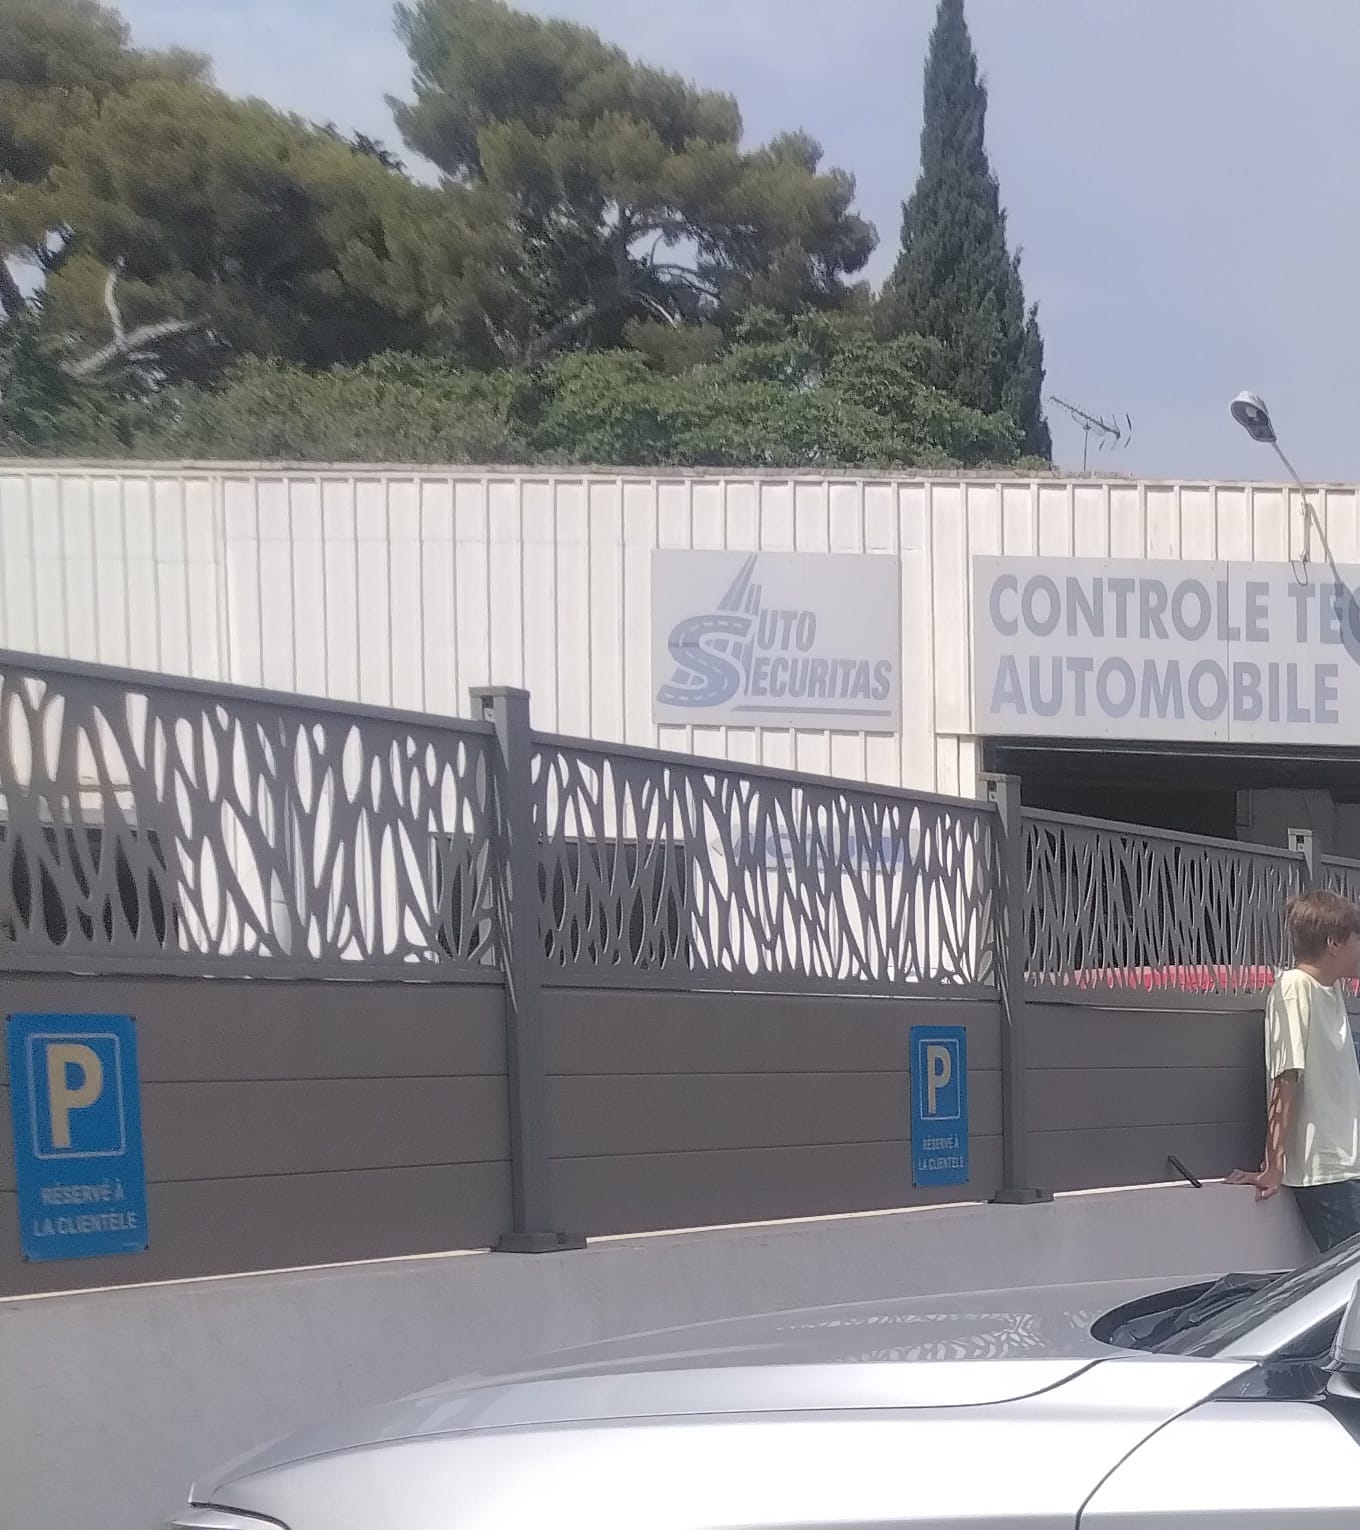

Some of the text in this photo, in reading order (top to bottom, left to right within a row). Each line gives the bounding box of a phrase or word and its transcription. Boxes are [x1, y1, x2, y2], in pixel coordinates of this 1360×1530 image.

[989, 574, 1270, 642] CONTROLE
[990, 655, 1340, 723] AUTOMOBILE
[46, 1043, 104, 1149] P
[926, 1045, 951, 1115] P
